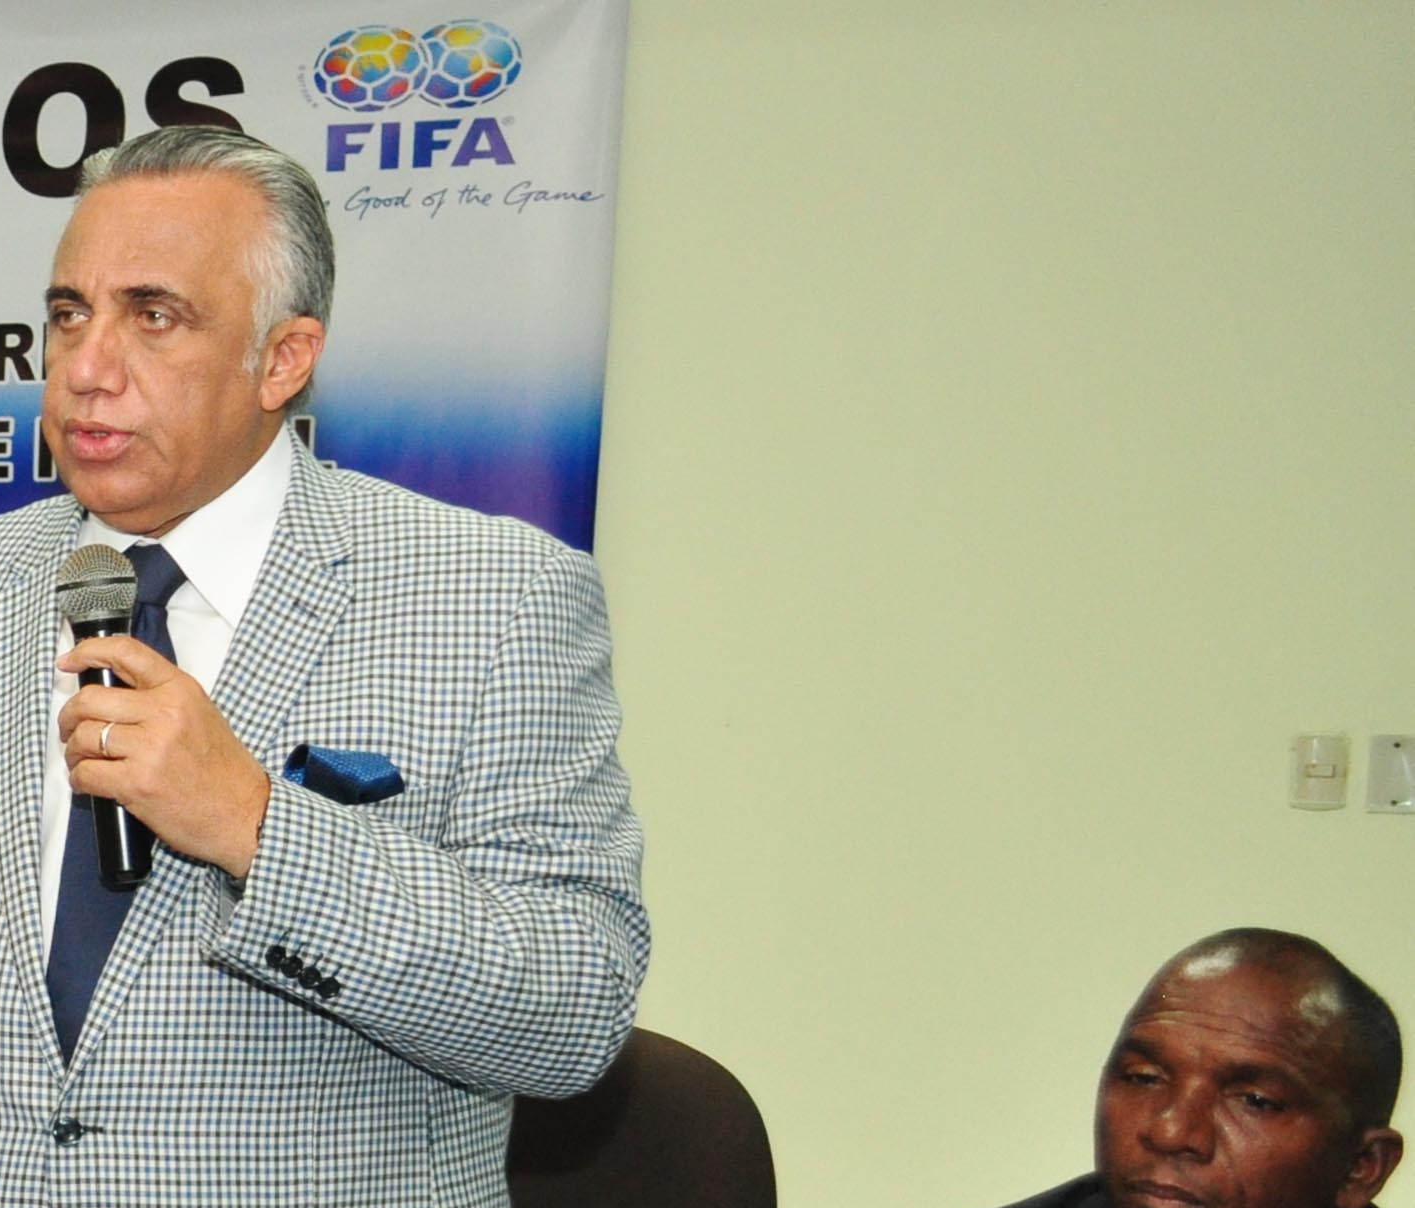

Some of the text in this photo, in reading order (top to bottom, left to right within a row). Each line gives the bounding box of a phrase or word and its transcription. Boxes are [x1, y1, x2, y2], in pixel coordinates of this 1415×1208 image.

[325, 116, 516, 173] FIFA
[343, 180, 605, 220] Good of the Game
